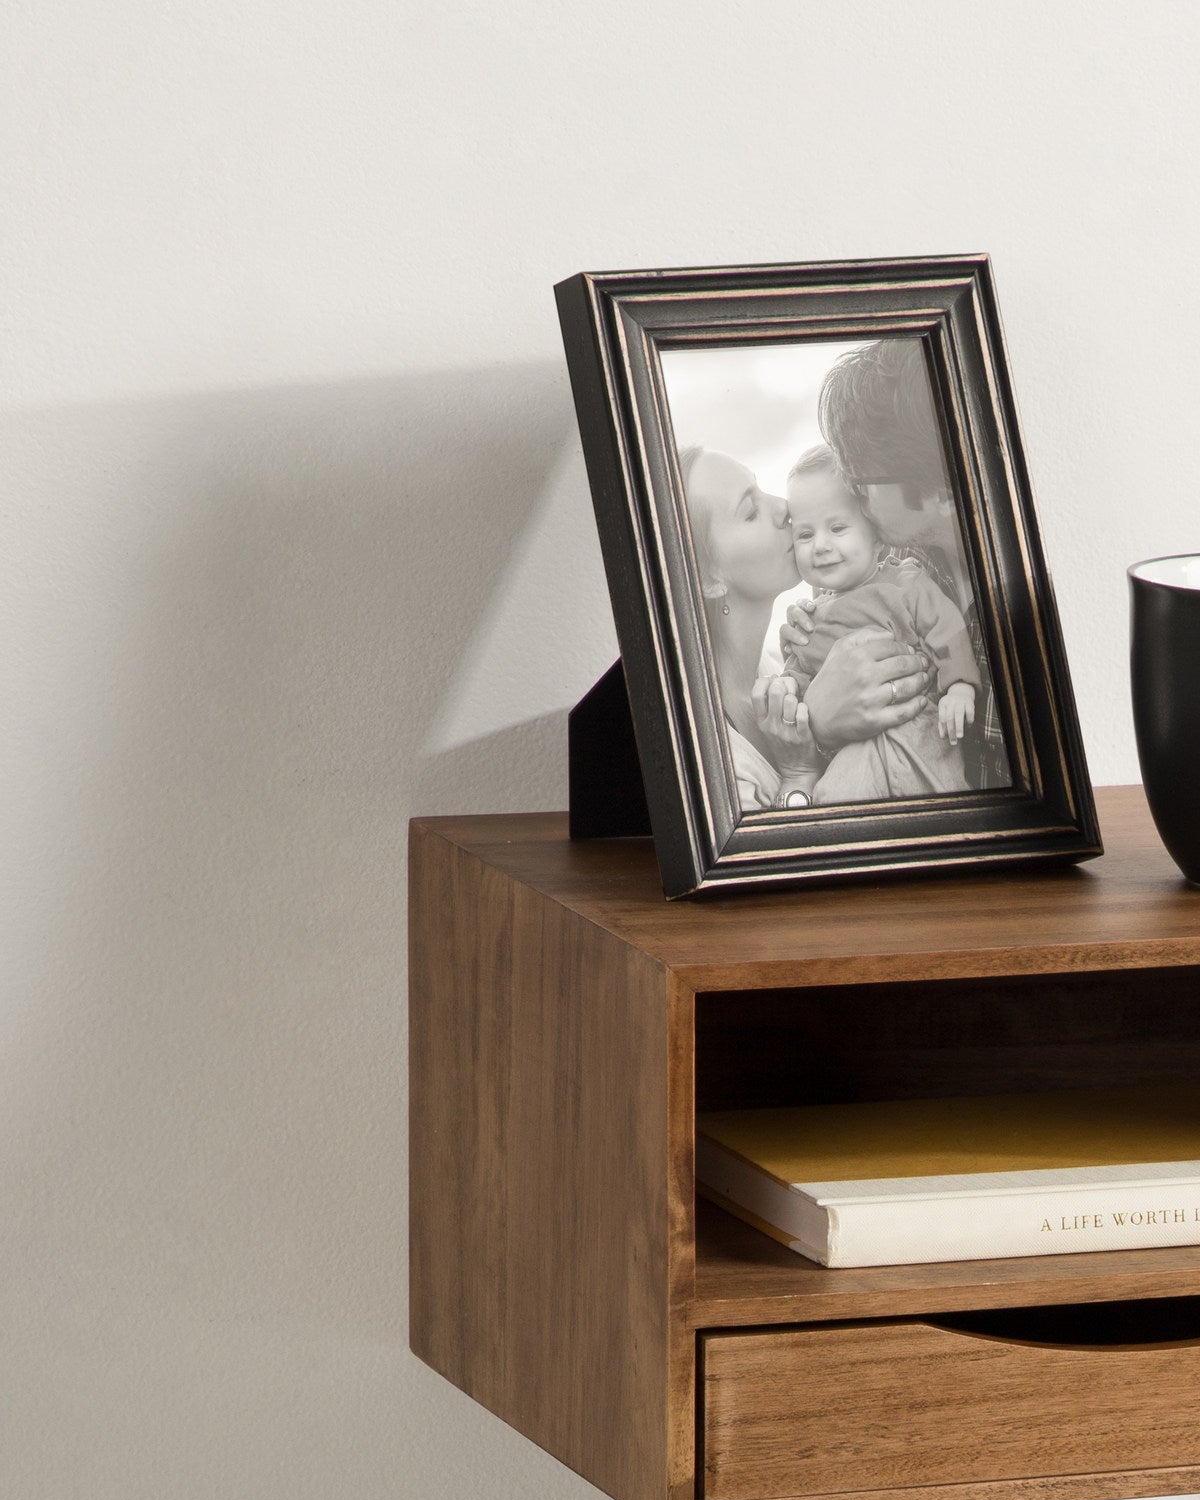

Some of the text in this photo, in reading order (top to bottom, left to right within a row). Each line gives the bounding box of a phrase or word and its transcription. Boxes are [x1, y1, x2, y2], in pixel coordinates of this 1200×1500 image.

[1040, 1218, 1053, 1232] A
[1061, 1214, 1104, 1231] LIFE
[1112, 1209, 1186, 1227] WORTH
